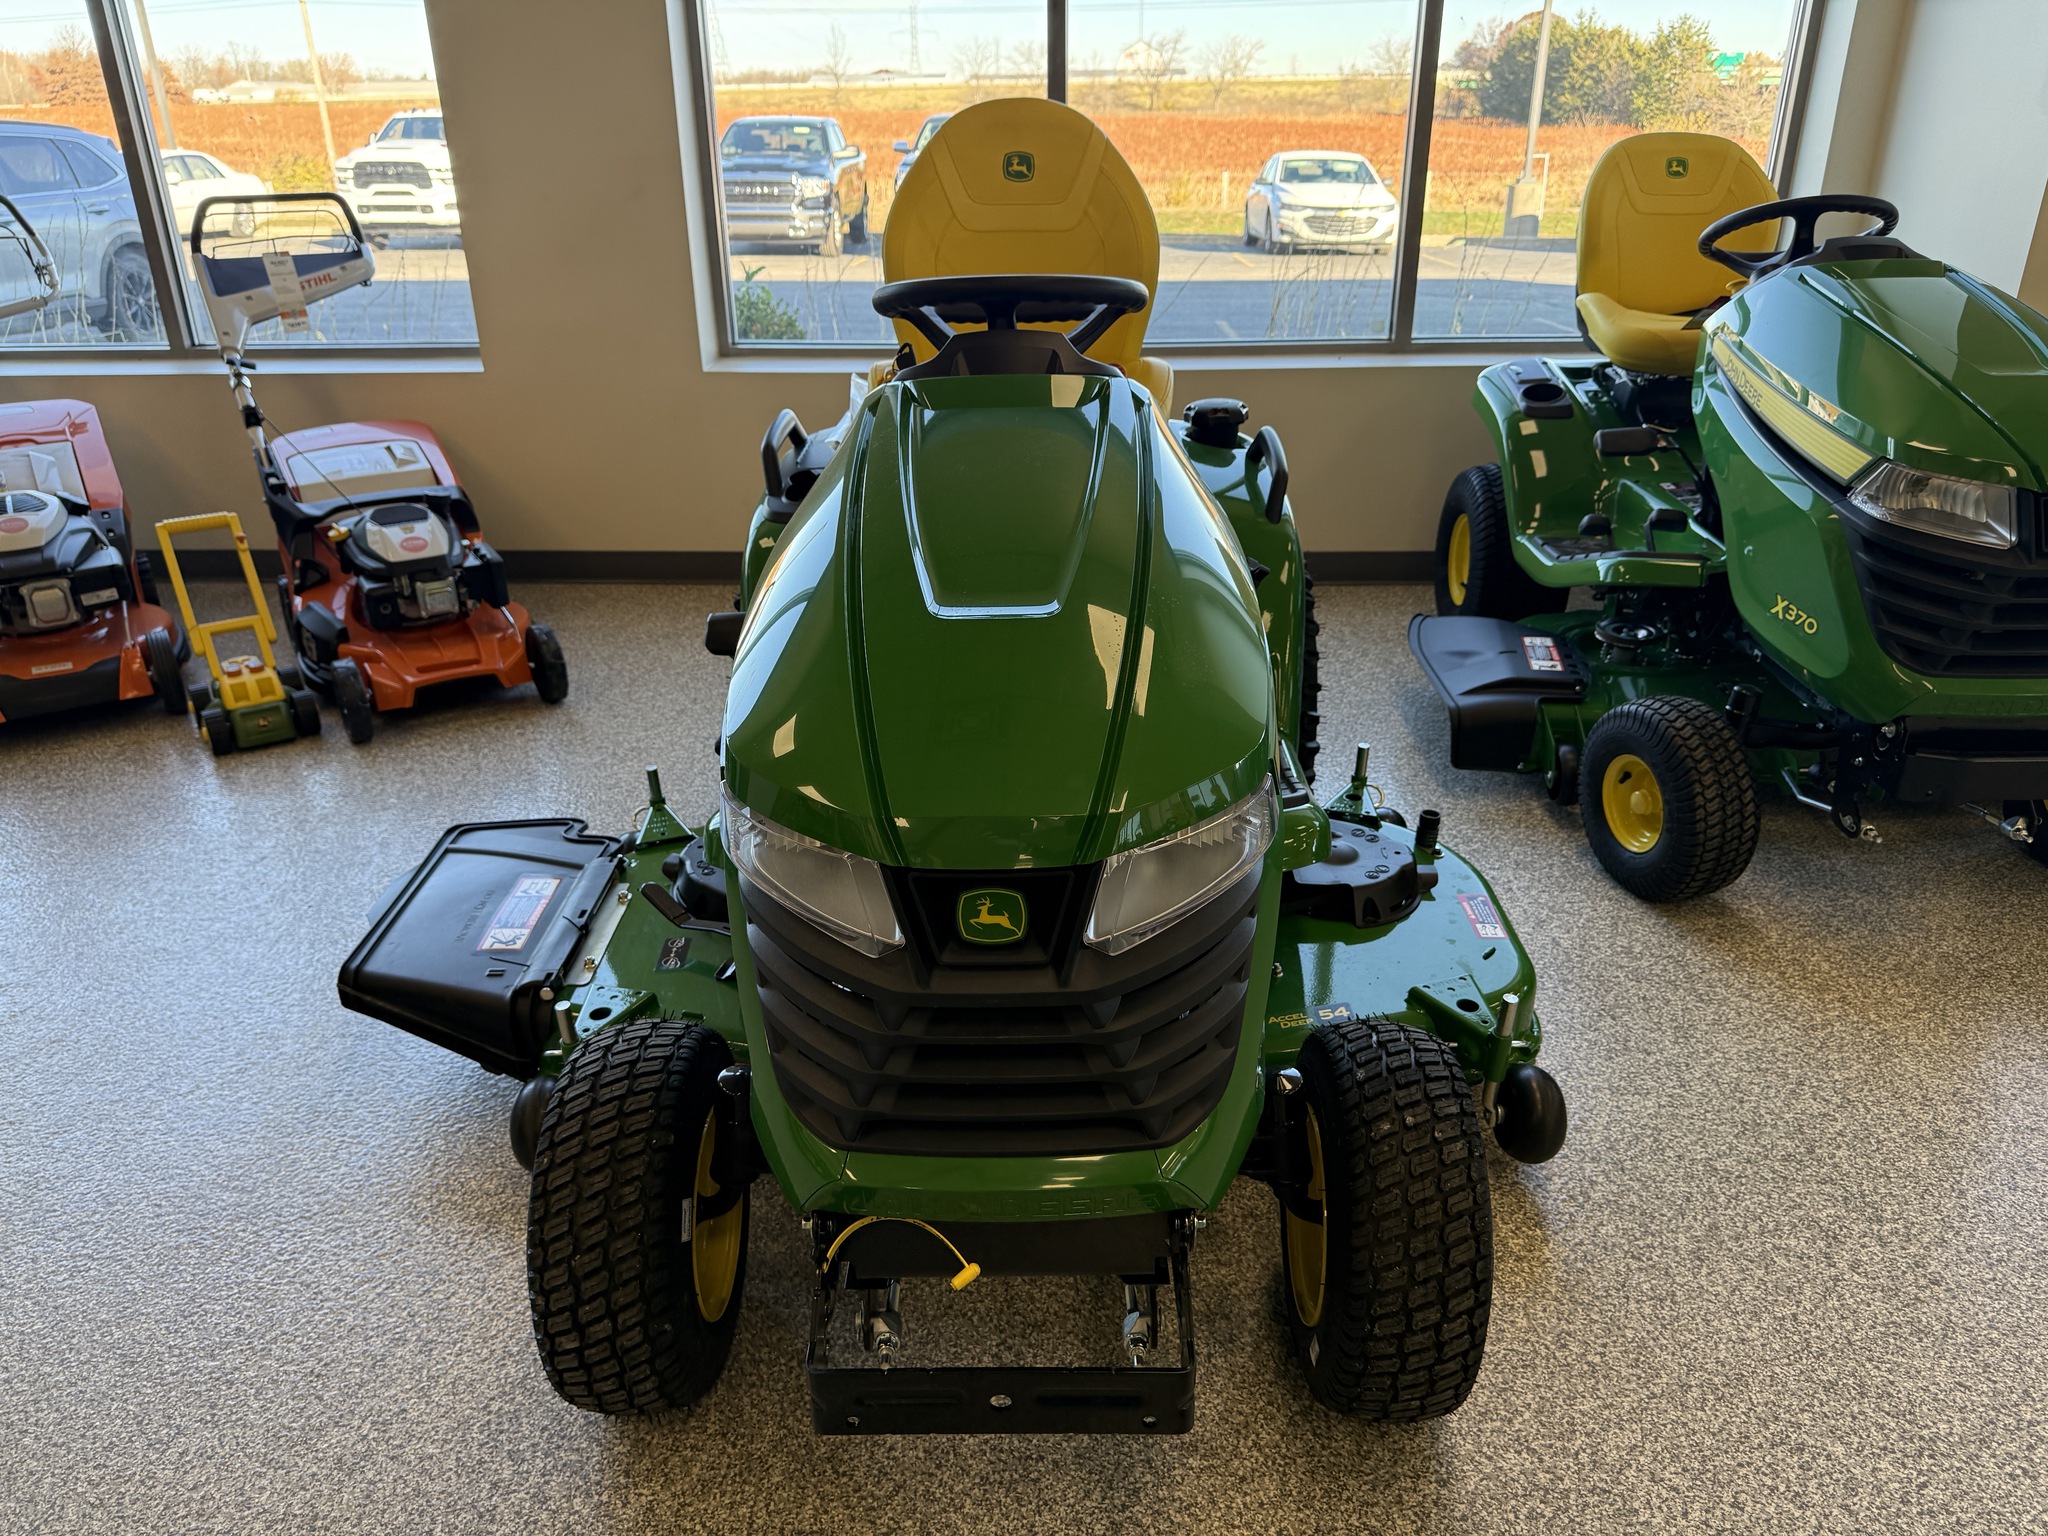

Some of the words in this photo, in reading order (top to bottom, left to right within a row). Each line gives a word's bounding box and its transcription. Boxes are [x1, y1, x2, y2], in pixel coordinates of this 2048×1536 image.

[1725, 355, 1741, 388] JOHN
[1738, 370, 1764, 409] DEERE
[1769, 593, 1819, 635] X370
[1268, 1012, 1308, 1024] ACCEL
[1318, 1006, 1350, 1020] 54
[1280, 1017, 1314, 1029] DEEP
